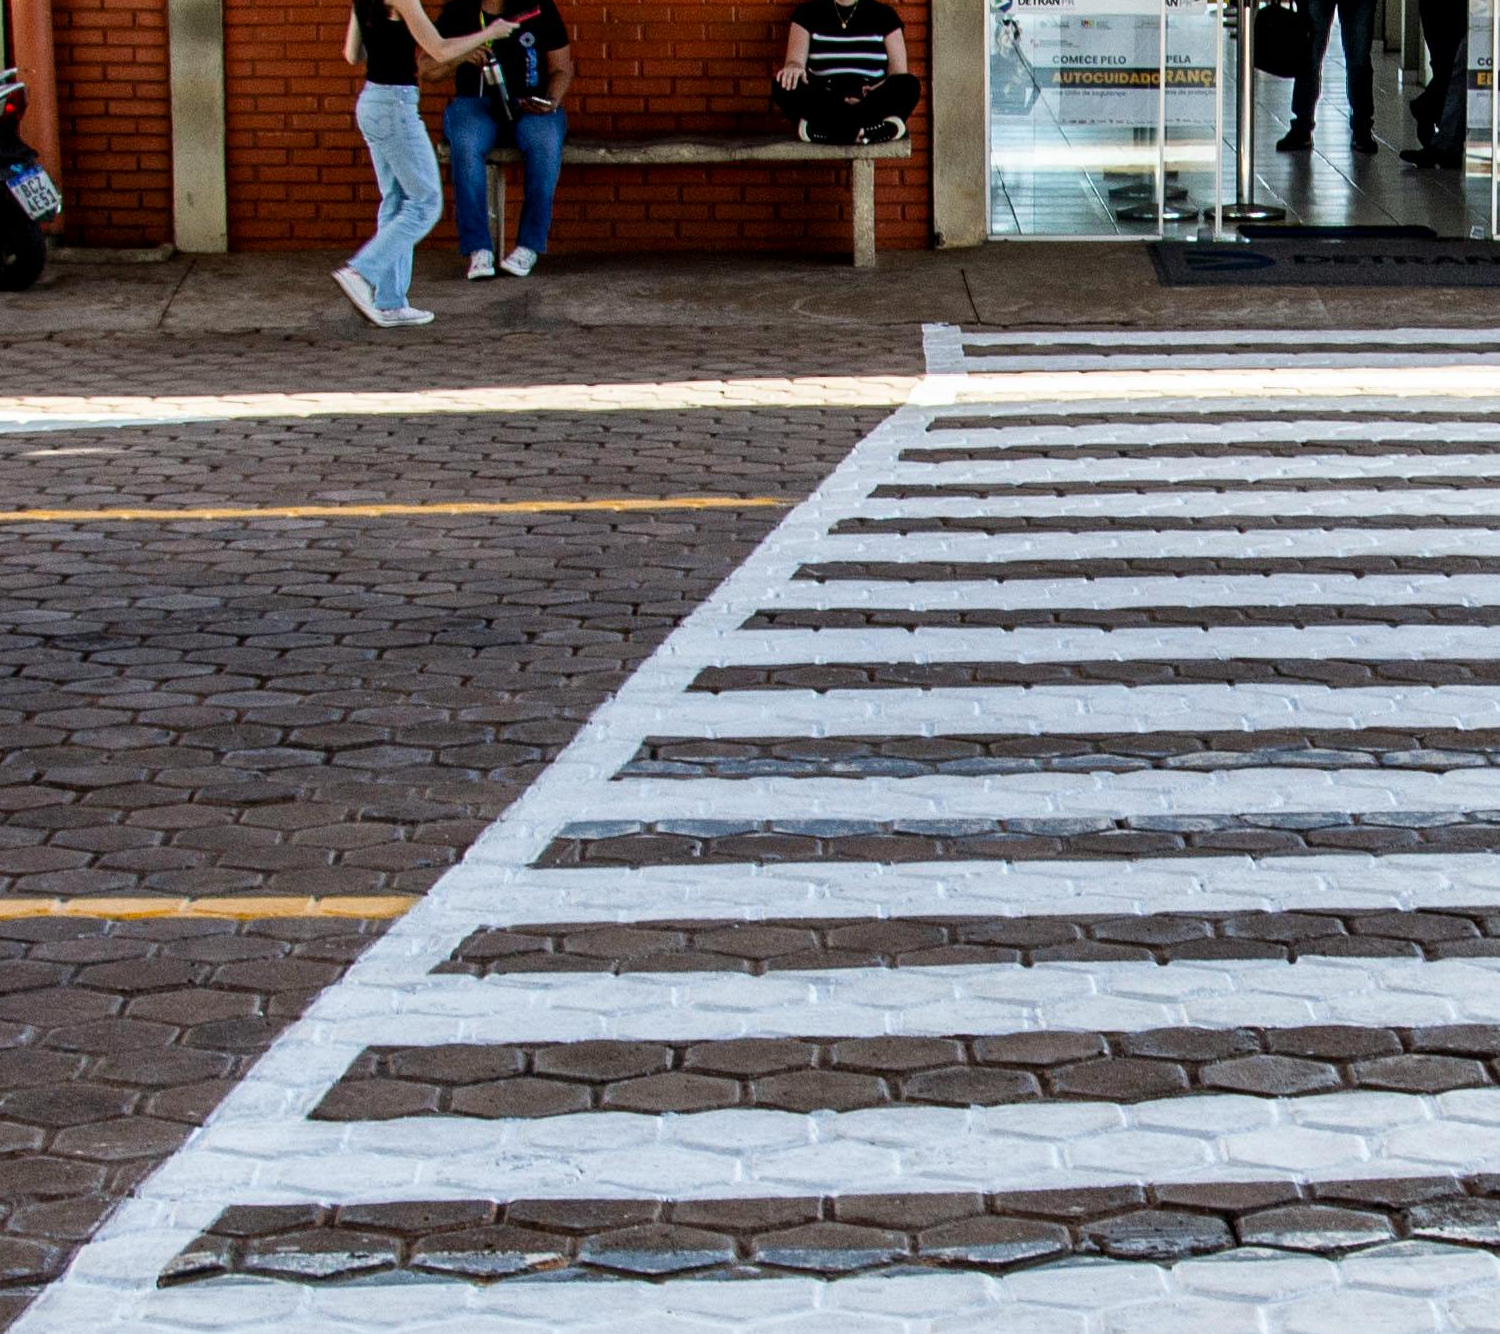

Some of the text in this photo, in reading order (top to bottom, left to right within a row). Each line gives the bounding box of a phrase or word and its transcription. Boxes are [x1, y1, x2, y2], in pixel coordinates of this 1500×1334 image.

[1052, 55, 1127, 65] COMECE PELO
[1166, 55, 1191, 64] PELA
[1052, 71, 1161, 84] AUTOCUIDADO
[20, 176, 45, 198] BCZ
